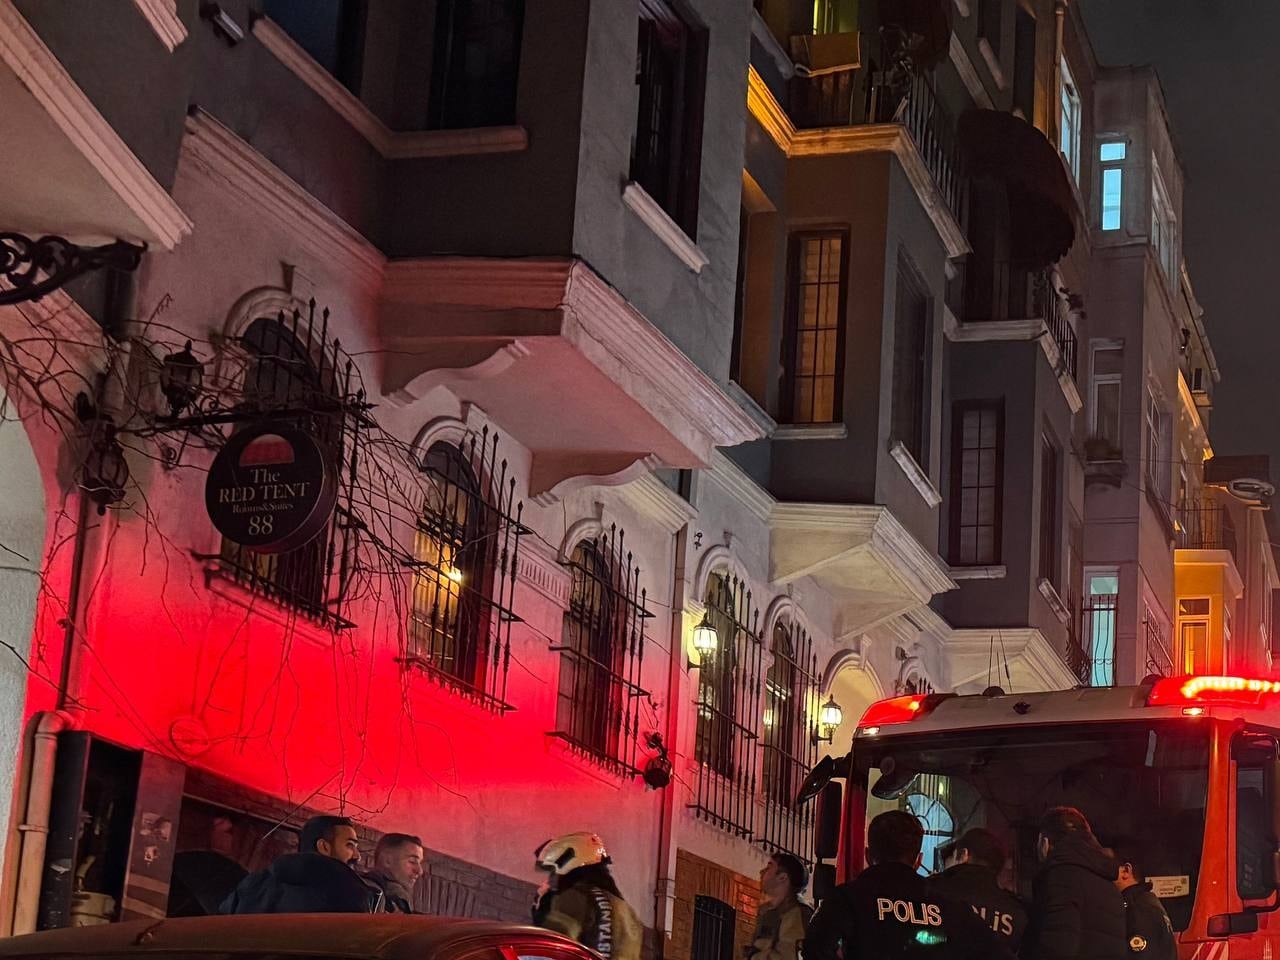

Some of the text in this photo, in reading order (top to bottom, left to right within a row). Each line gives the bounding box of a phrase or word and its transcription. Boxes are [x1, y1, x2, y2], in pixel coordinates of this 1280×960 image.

[251, 468, 281, 484] The
[219, 482, 310, 503] RED TENT
[248, 514, 274, 536] 88
